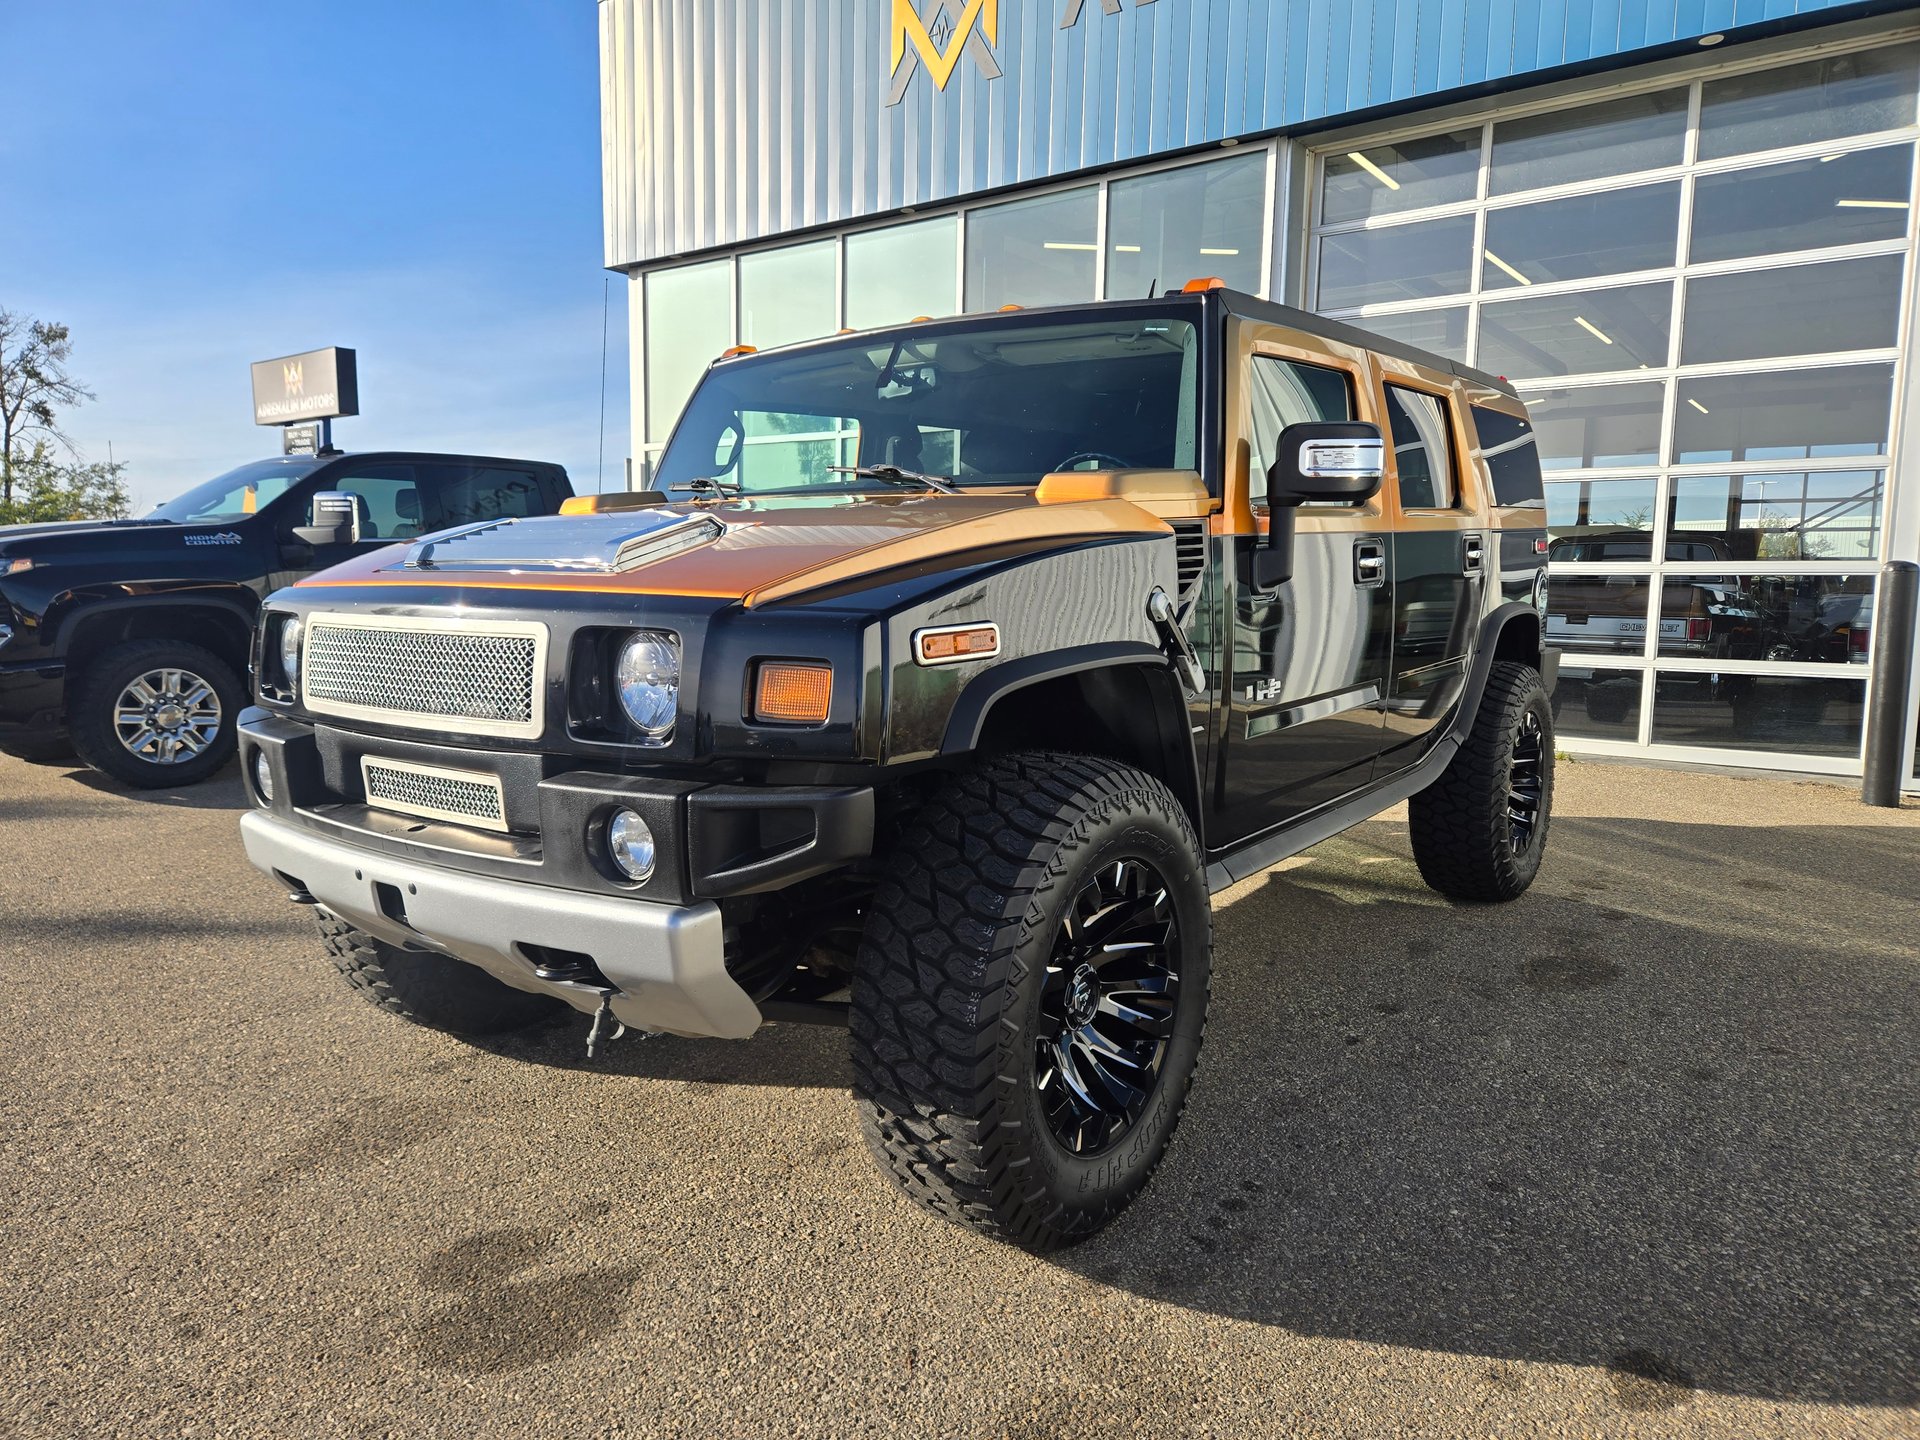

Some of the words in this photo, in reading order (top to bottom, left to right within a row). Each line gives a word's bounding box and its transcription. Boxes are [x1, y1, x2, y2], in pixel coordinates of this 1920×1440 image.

[257, 398, 299, 418] ADRENALIN
[300, 392, 335, 410] MOTORS
[1620, 623, 1680, 632] CHEVLET
